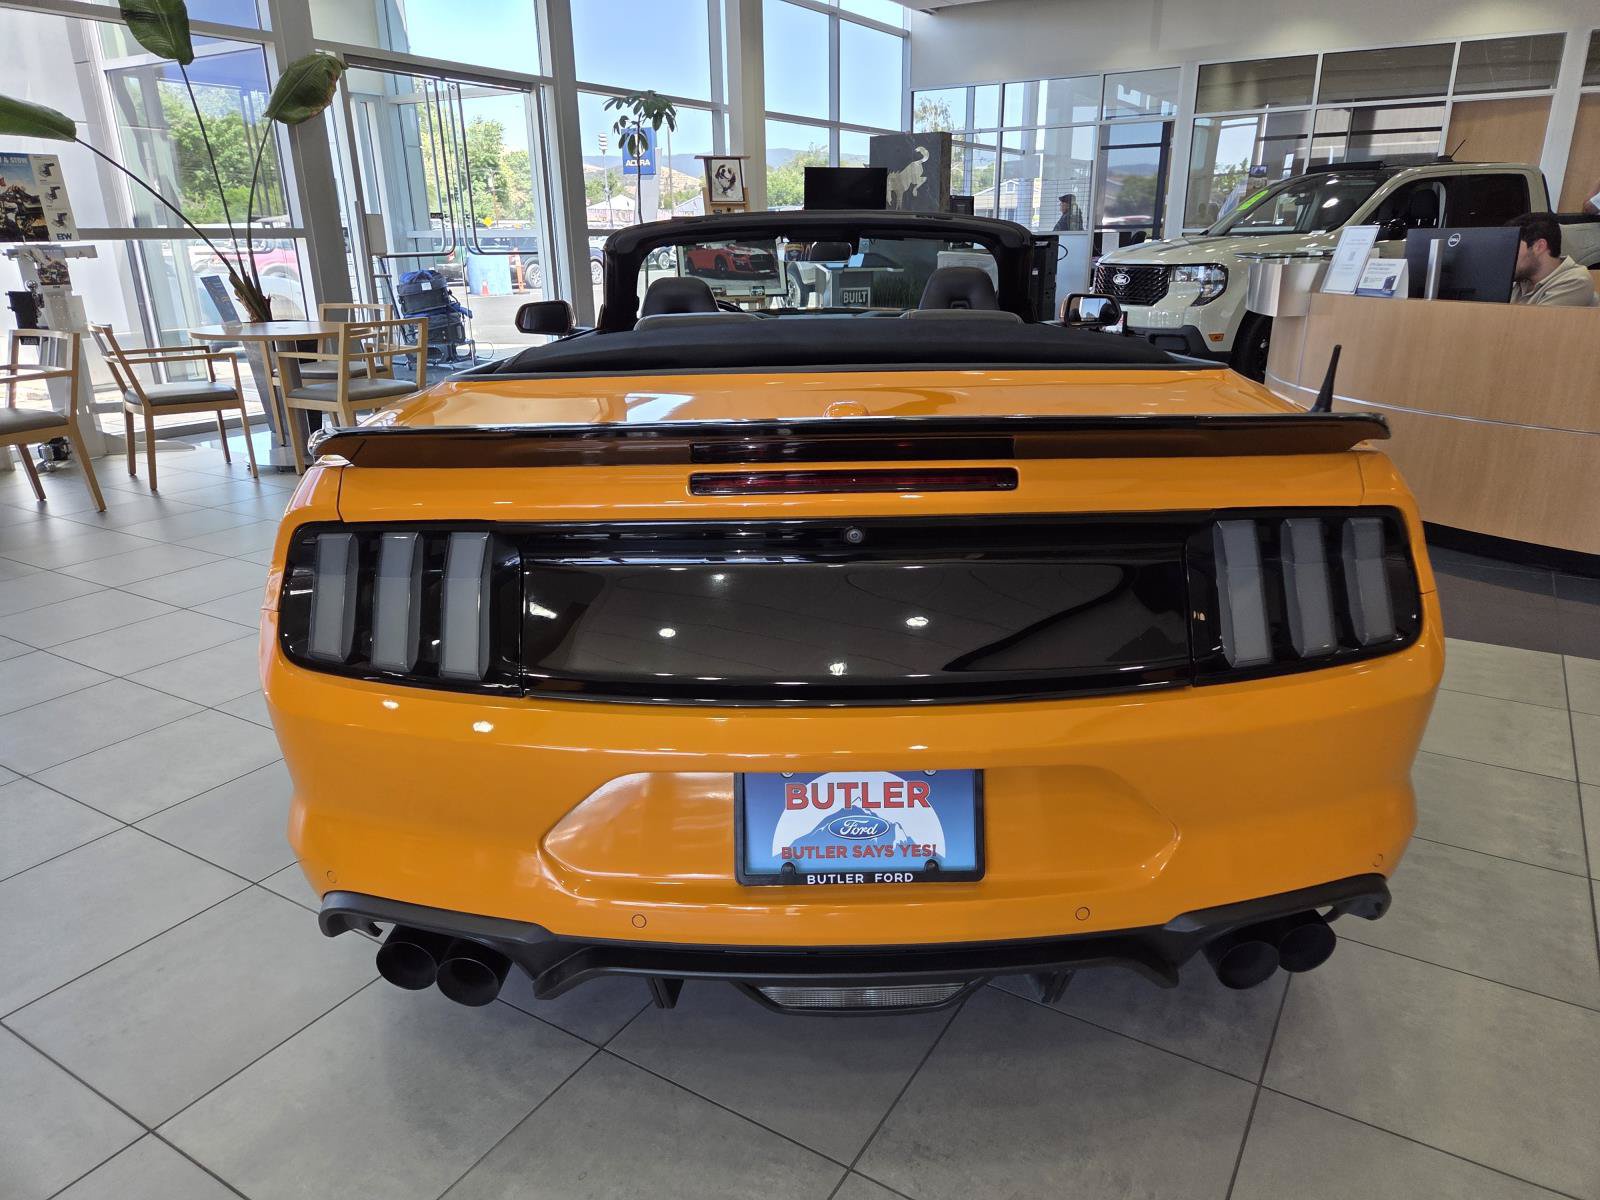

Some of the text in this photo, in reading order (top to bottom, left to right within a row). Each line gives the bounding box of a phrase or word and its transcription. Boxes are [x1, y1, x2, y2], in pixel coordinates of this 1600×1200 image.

[626, 159, 651, 167] ACRA
[843, 291, 867, 303] BUILT
[785, 781, 931, 810] BUTLER
[839, 819, 879, 837] Ford
[781, 843, 937, 860] BUTLER SAYS YES!
[807, 872, 914, 885] BUTLER FORD
